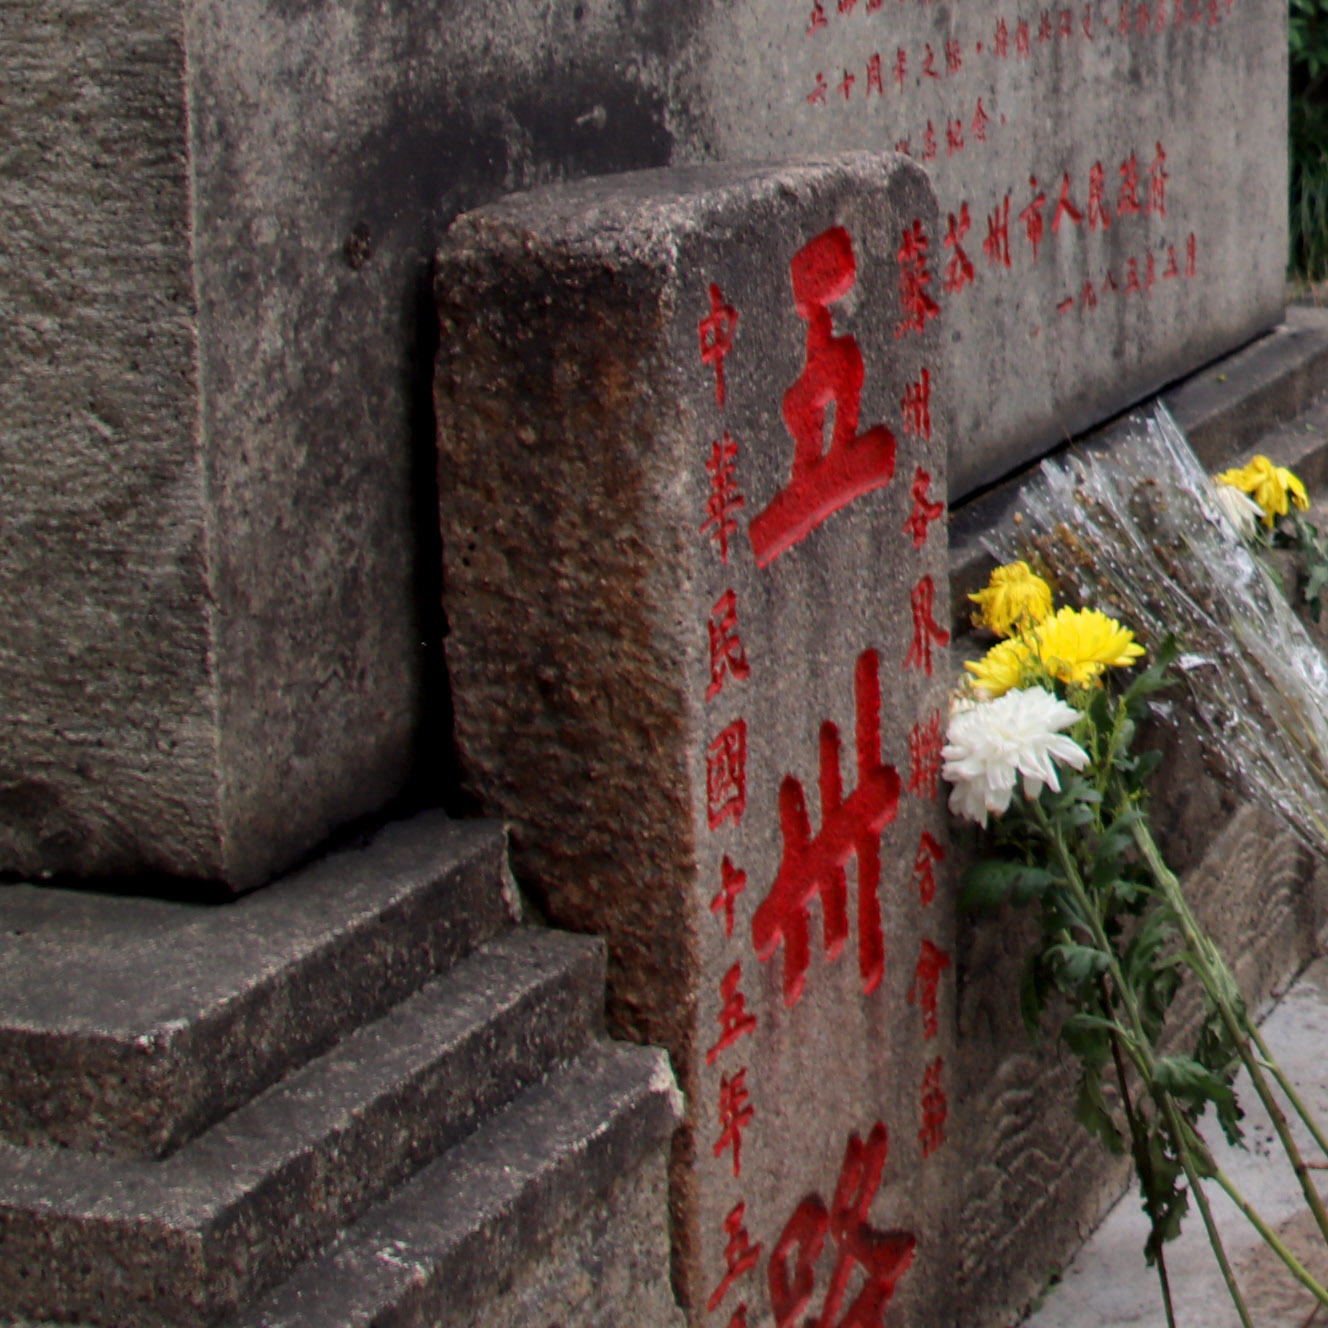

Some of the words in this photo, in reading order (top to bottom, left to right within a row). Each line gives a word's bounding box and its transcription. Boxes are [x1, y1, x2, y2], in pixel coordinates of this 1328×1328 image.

[943, 140, 1169, 294] 苏州市人民政府
